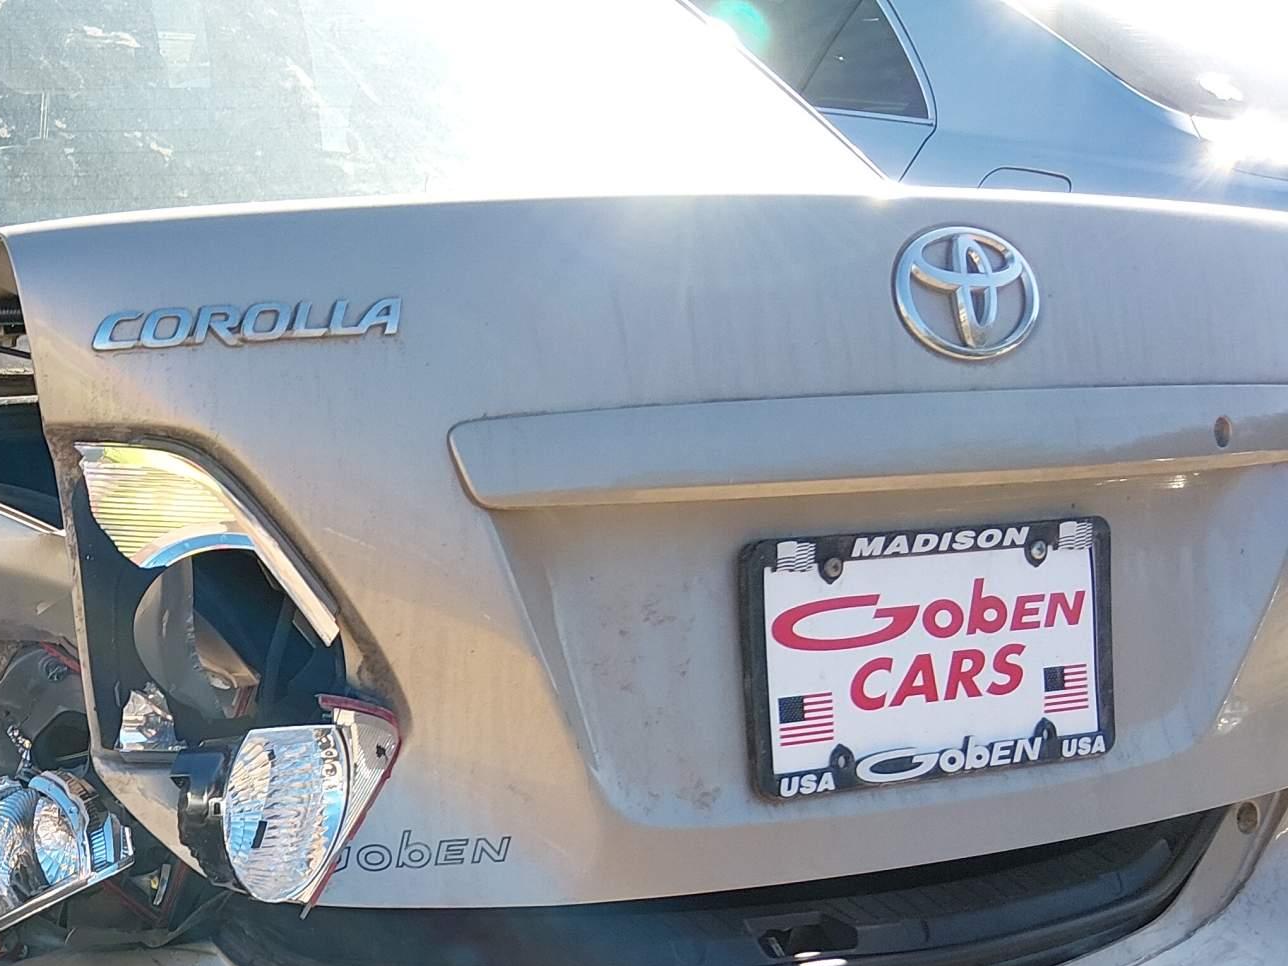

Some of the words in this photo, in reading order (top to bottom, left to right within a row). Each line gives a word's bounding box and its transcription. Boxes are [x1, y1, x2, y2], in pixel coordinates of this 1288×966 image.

[91, 296, 402, 351] COROLLA
[850, 526, 1031, 558] MADISON
[849, 643, 1027, 711] CARS
[779, 772, 836, 798] USA
[1061, 735, 1107, 759] USA
[332, 830, 512, 874] obEN
